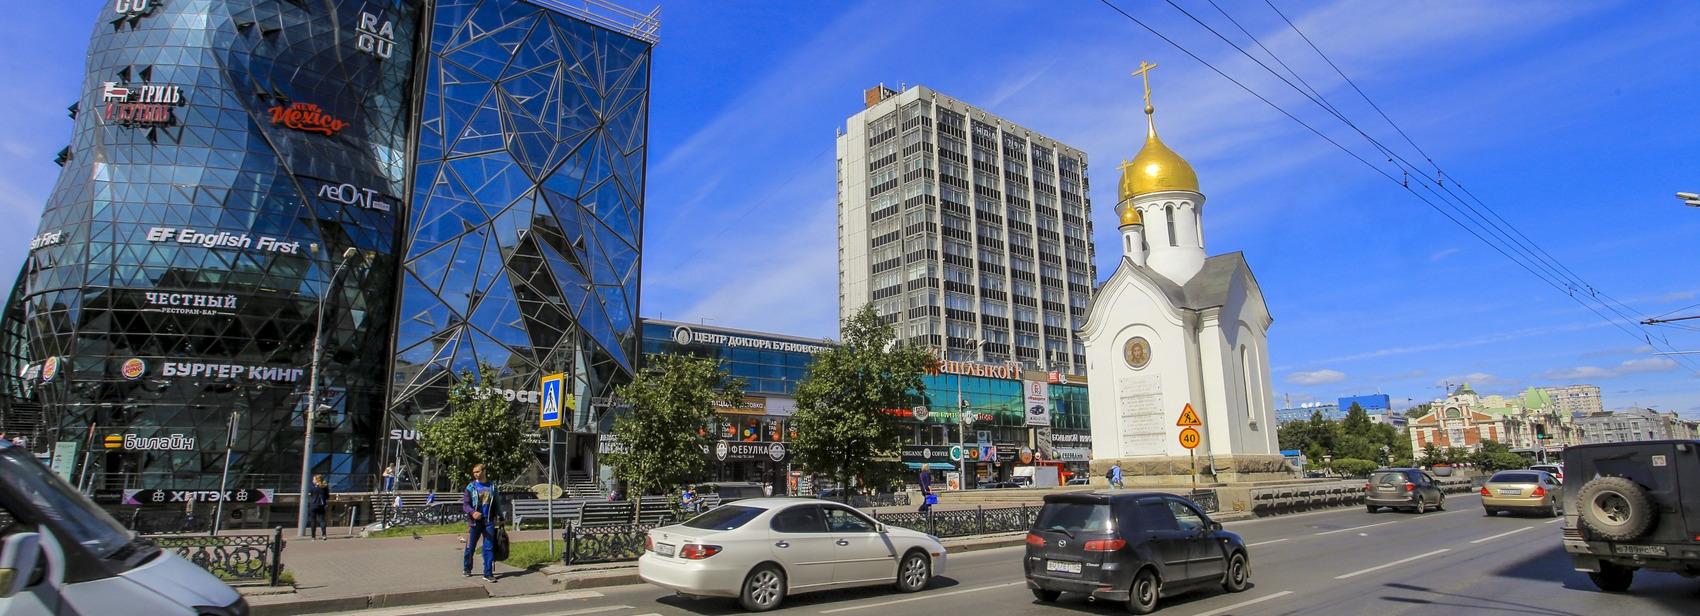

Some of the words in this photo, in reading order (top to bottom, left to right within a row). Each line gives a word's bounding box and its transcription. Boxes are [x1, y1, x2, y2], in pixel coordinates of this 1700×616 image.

[361, 11, 394, 40] RA
[139, 85, 181, 103] ГРИЛЬ
[267, 105, 350, 136] Mexico
[146, 226, 176, 243] EF
[176, 228, 252, 248] English
[255, 236, 300, 255] First
[145, 292, 238, 309] ЧЕСТНЫЙ
[694, 332, 727, 344] ЦЕНТР
[728, 335, 772, 349] ДОКТОРА
[162, 362, 245, 379] БУРГЕР
[248, 366, 304, 382] КИНГ
[124, 434, 195, 450] билайн
[390, 428, 422, 440] SU
[1183, 434, 1196, 443] 40
